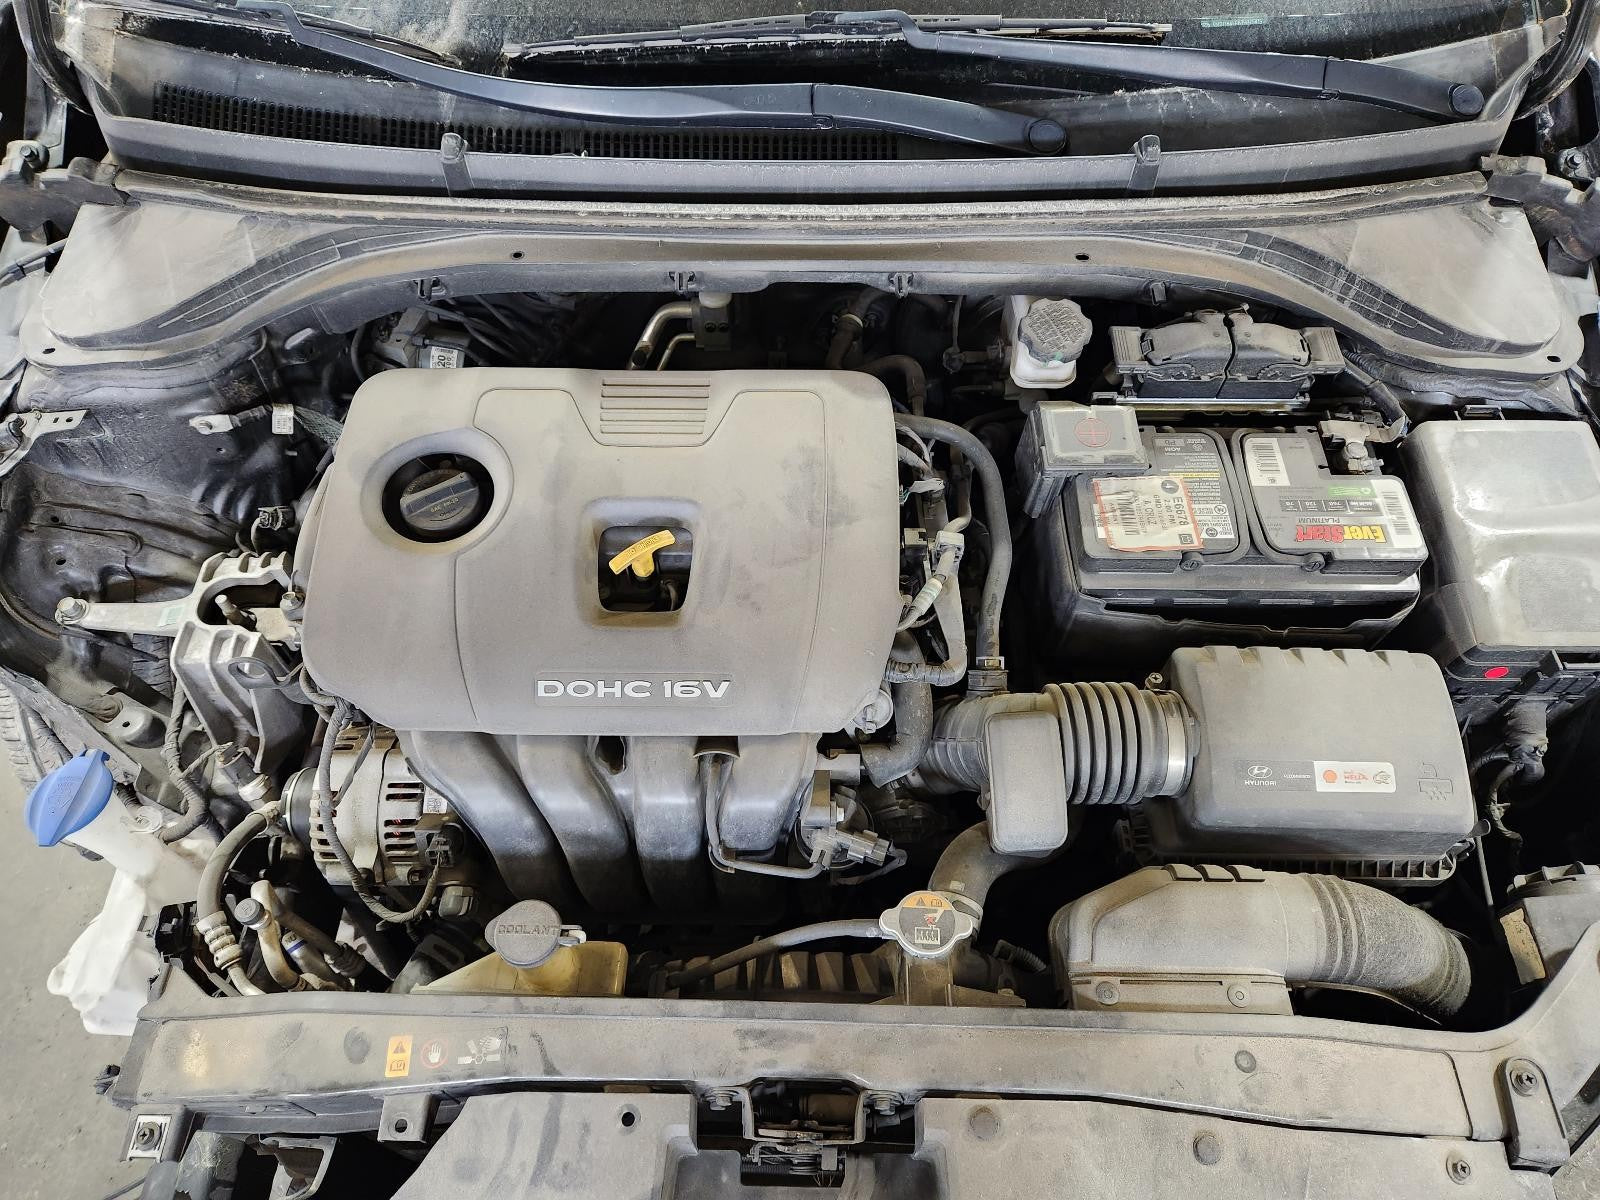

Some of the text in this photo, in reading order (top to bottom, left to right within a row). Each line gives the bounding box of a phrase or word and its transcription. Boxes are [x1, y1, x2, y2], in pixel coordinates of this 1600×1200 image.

[1297, 525, 1387, 543] EverStart
[537, 679, 732, 698] DOHC 16V
[498, 923, 562, 937] COOLANT
